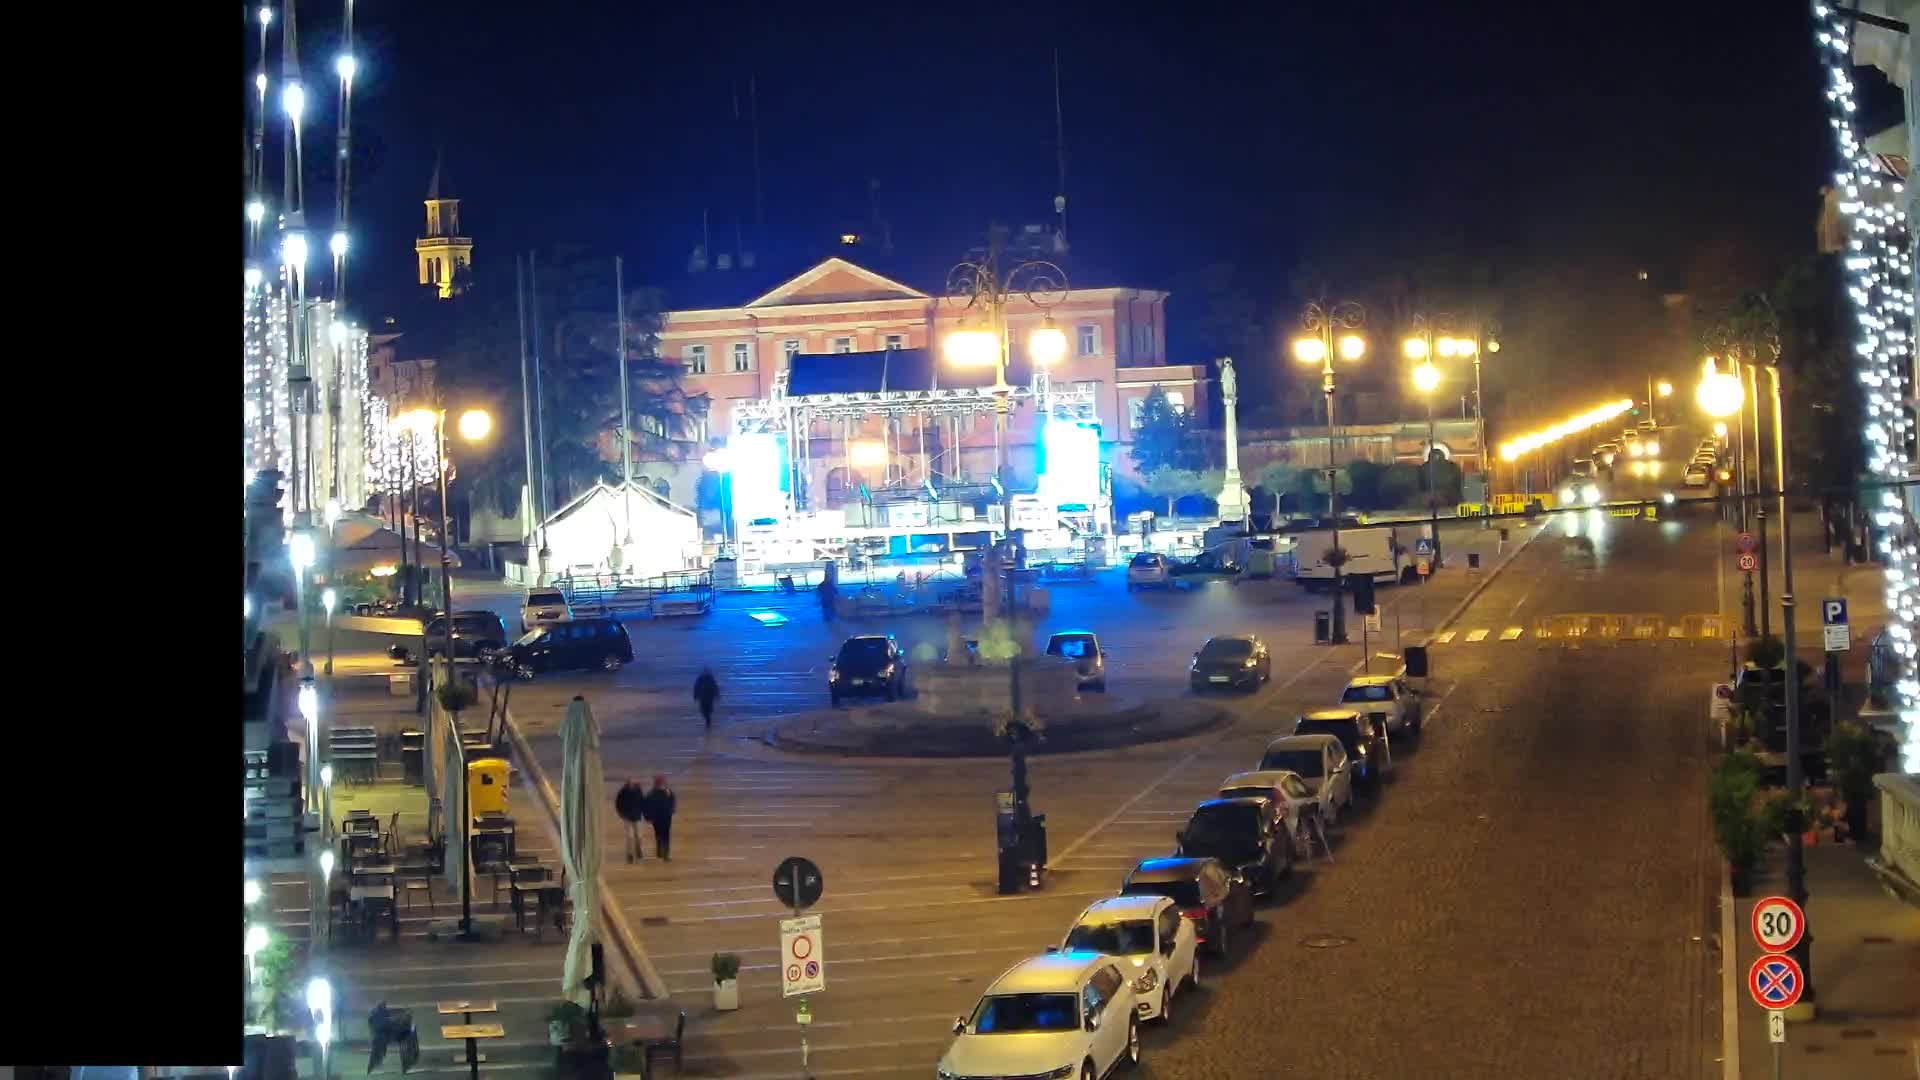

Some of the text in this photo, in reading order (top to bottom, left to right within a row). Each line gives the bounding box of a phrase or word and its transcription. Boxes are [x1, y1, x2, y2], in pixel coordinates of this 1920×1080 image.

[1742, 557, 1753, 567] 20
[1828, 602, 1842, 622] P
[1762, 912, 1791, 937] 30
